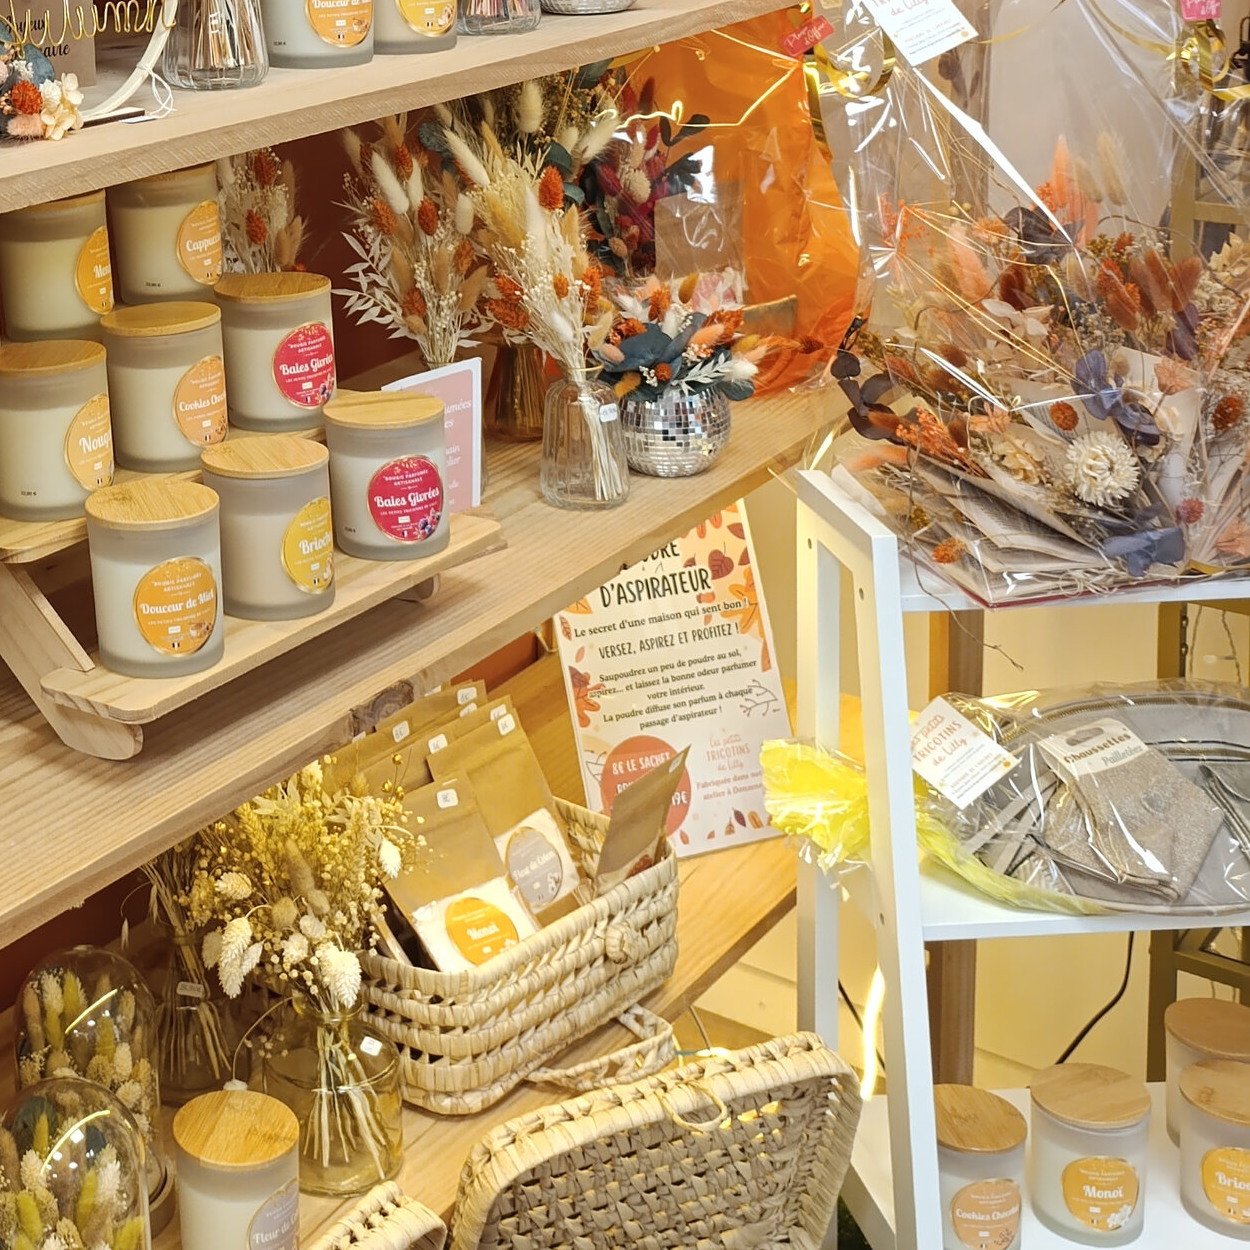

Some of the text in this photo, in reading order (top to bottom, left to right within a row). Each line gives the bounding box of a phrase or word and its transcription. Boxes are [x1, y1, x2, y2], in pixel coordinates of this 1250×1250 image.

[279, 362, 310, 376] Baies
[179, 397, 210, 412] Cookies
[374, 487, 440, 508] Baies Givrées
[642, 542, 680, 562] DRE
[600, 568, 711, 608] D'ASPIRATEUR
[140, 589, 214, 614] Douceur de Miel
[574, 628, 586, 638] Le
[588, 622, 617, 635] secret
[619, 617, 646, 630] d'une
[648, 612, 682, 625] maison
[684, 607, 700, 622] qui
[702, 604, 721, 615] sent
[723, 599, 742, 610] bon
[599, 642, 636, 659] VERSEZ,
[639, 635, 675, 651] ASPIREZ
[679, 631, 689, 644] ET
[692, 623, 732, 641] PROFITEZ
[599, 667, 646, 683] Saupoudrez
[647, 666, 659, 674] un
[660, 663, 675, 673] peu
[677, 660, 686, 668] de
[688, 655, 715, 668] poudre
[728, 649, 742, 658] sol,
[625, 683, 634, 691] et
[635, 679, 661, 690] laissez
[662, 676, 670, 684] la
[671, 672, 695, 682] bonne
[697, 667, 719, 677] odeur
[721, 659, 757, 674] parfumer
[647, 682, 705, 700] votre intérieur.
[603, 686, 753, 723] La poudre diffuse son parfum à chaque
[639, 717, 669, 731] passage
[671, 707, 717, 723] d'aspirateur
[706, 743, 750, 762] TRICOTINS
[913, 720, 962, 762] TRICOTINS
[1063, 732, 1132, 764] Chaussettes
[612, 763, 624, 776] 8€
[626, 759, 637, 772] LE
[1083, 1185, 1124, 1198] Monoï
[956, 1208, 991, 1221] Cookies
